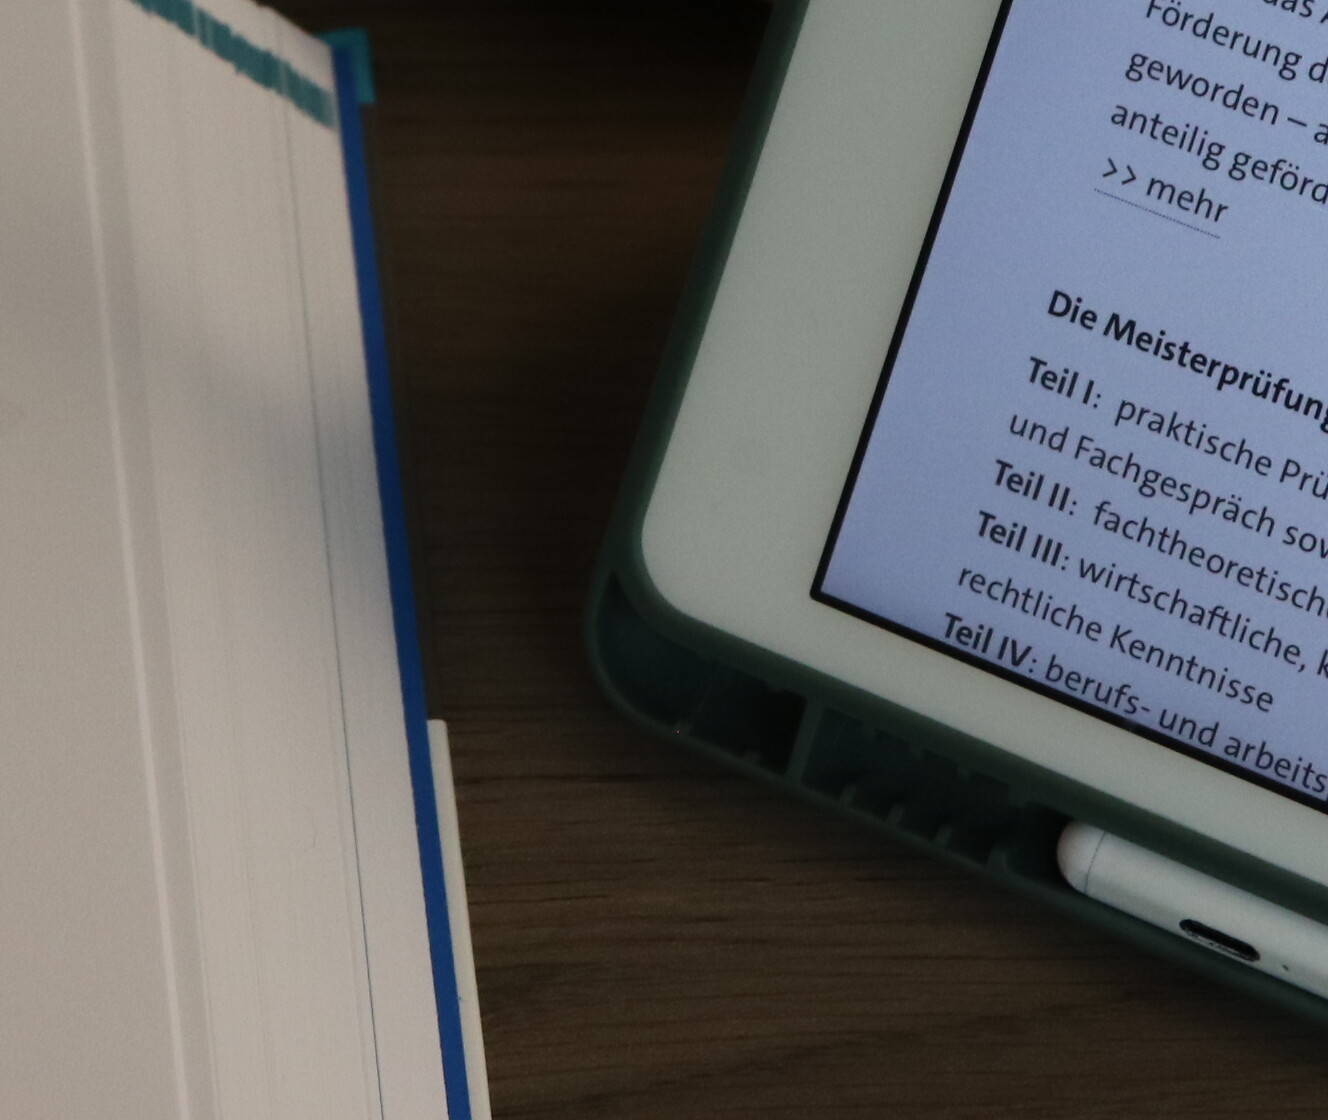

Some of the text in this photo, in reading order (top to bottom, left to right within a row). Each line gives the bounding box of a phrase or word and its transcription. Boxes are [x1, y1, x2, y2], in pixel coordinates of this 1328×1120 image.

[1109, 104, 1226, 171] anteilig
[1124, 52, 1279, 126] geworden
[1145, 176, 1228, 222] mehr
[1046, 289, 1098, 331] Die
[1028, 355, 1079, 398] Teil
[1081, 378, 1101, 409] I:
[1113, 399, 1272, 477] praktische
[994, 458, 1045, 501] Teil
[1047, 481, 1077, 516] II:
[1008, 413, 1070, 453] und
[1073, 434, 1275, 537] Fachgespräch
[977, 509, 1028, 552] Teil
[1029, 533, 1069, 571] III:
[1078, 557, 1305, 672] wirtschaftliche,
[943, 611, 994, 654] Teil
[996, 635, 1037, 673] IV:
[1044, 654, 1149, 715] berufs-
[1157, 708, 1220, 750] und
[957, 567, 1274, 713] rechtliche Kenntnisse
